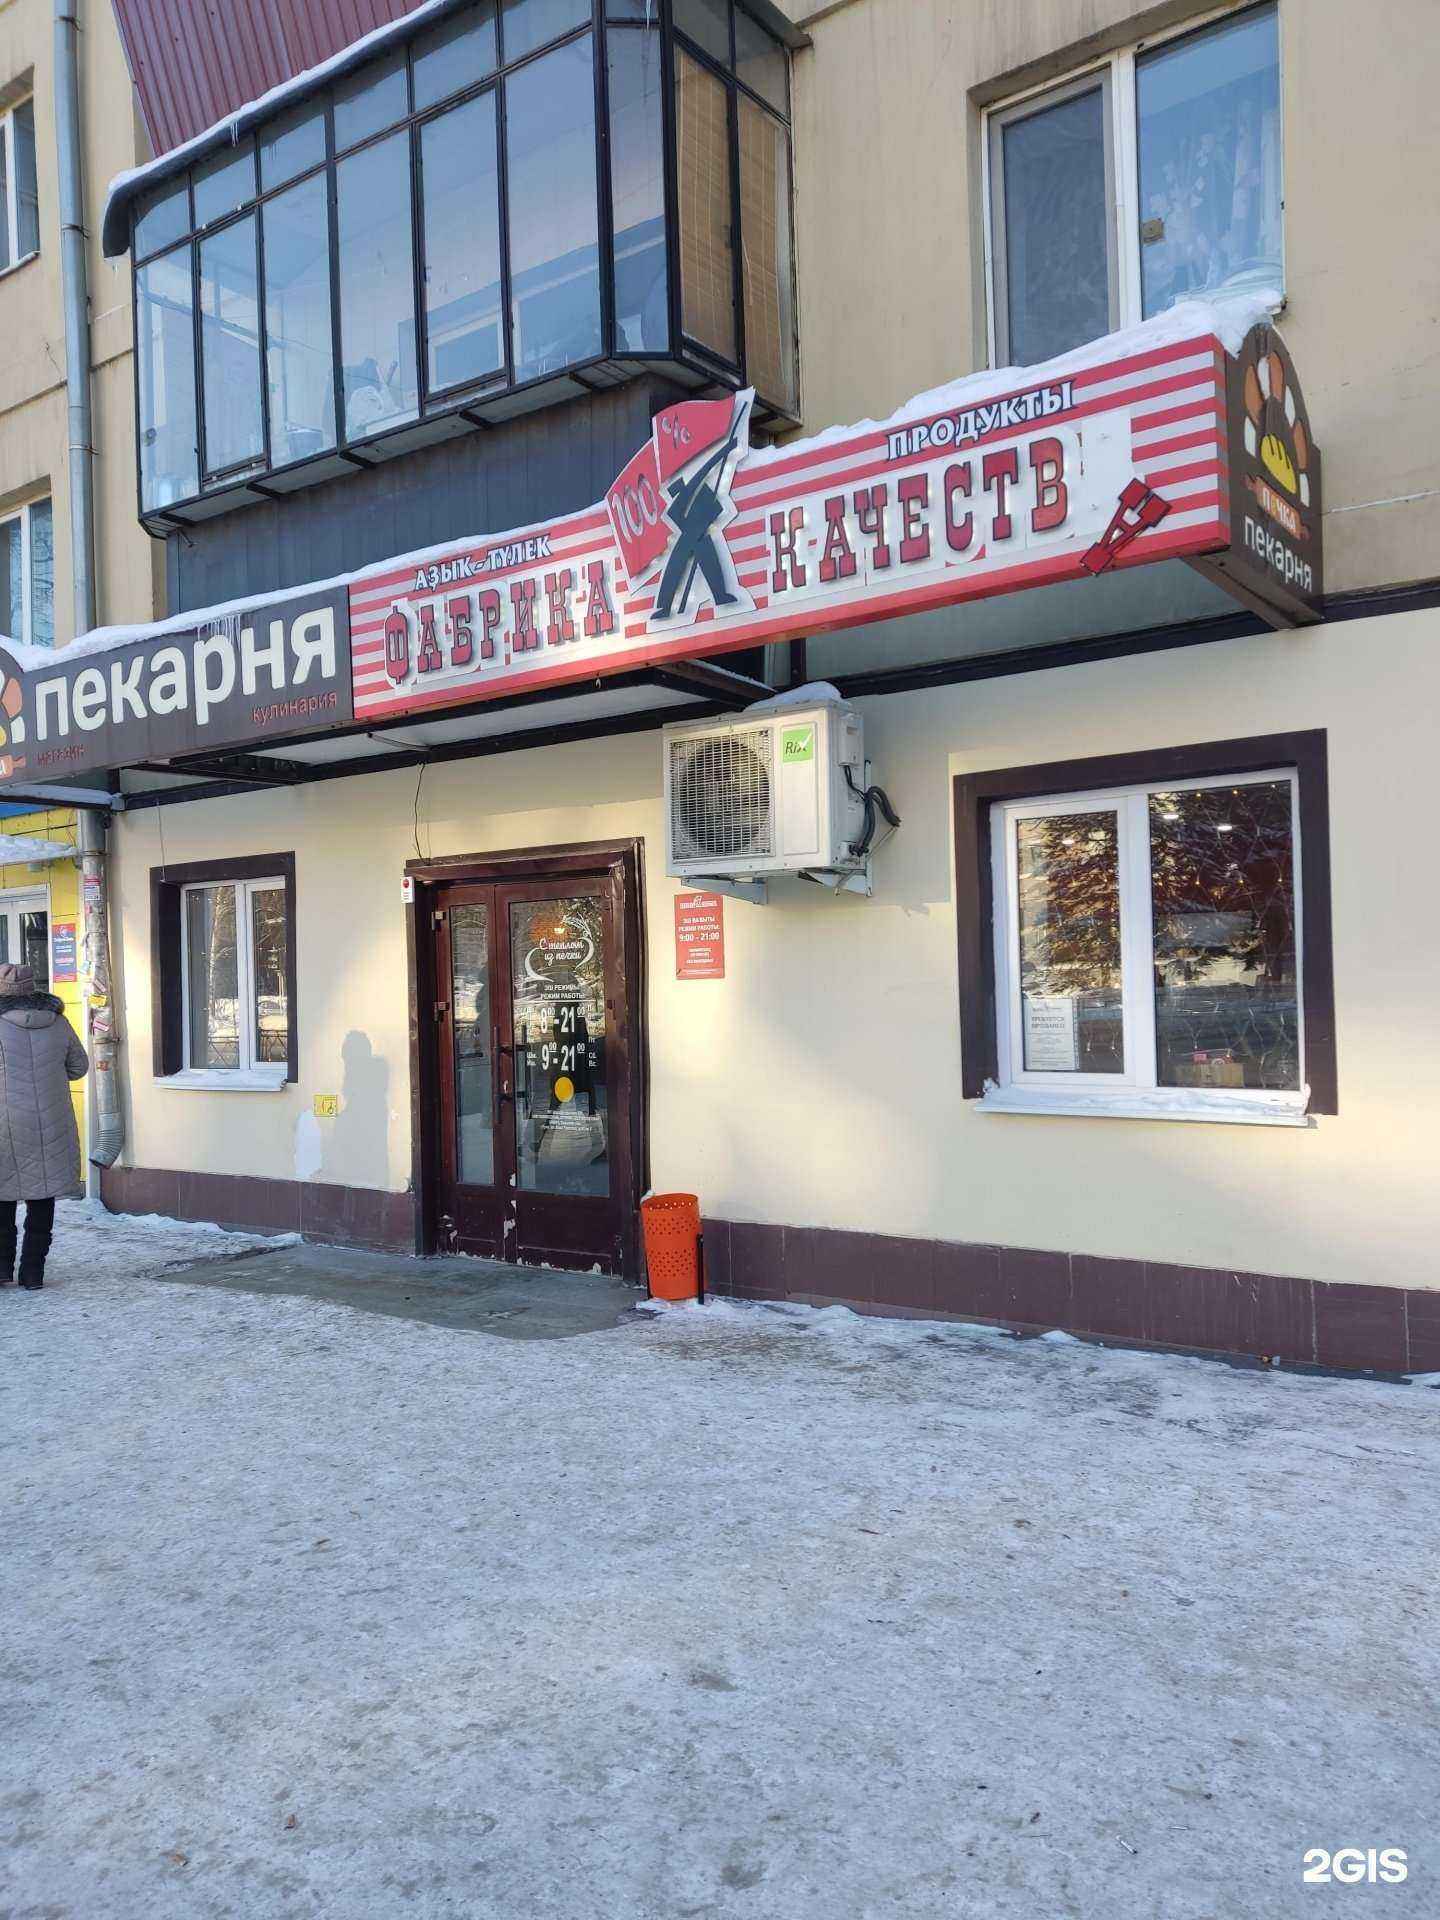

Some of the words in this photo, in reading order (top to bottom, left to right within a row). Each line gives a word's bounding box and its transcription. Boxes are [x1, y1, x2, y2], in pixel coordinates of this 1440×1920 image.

[887, 380, 1077, 461] ПРОДУКТЫ
[612, 474, 658, 544] 100
[1262, 487, 1298, 533] ПЧКА
[1244, 515, 1313, 593] пекарня
[384, 559, 615, 686] ФАБРИКА
[35, 606, 337, 742] пекарня
[252, 690, 337, 727] кулинария
